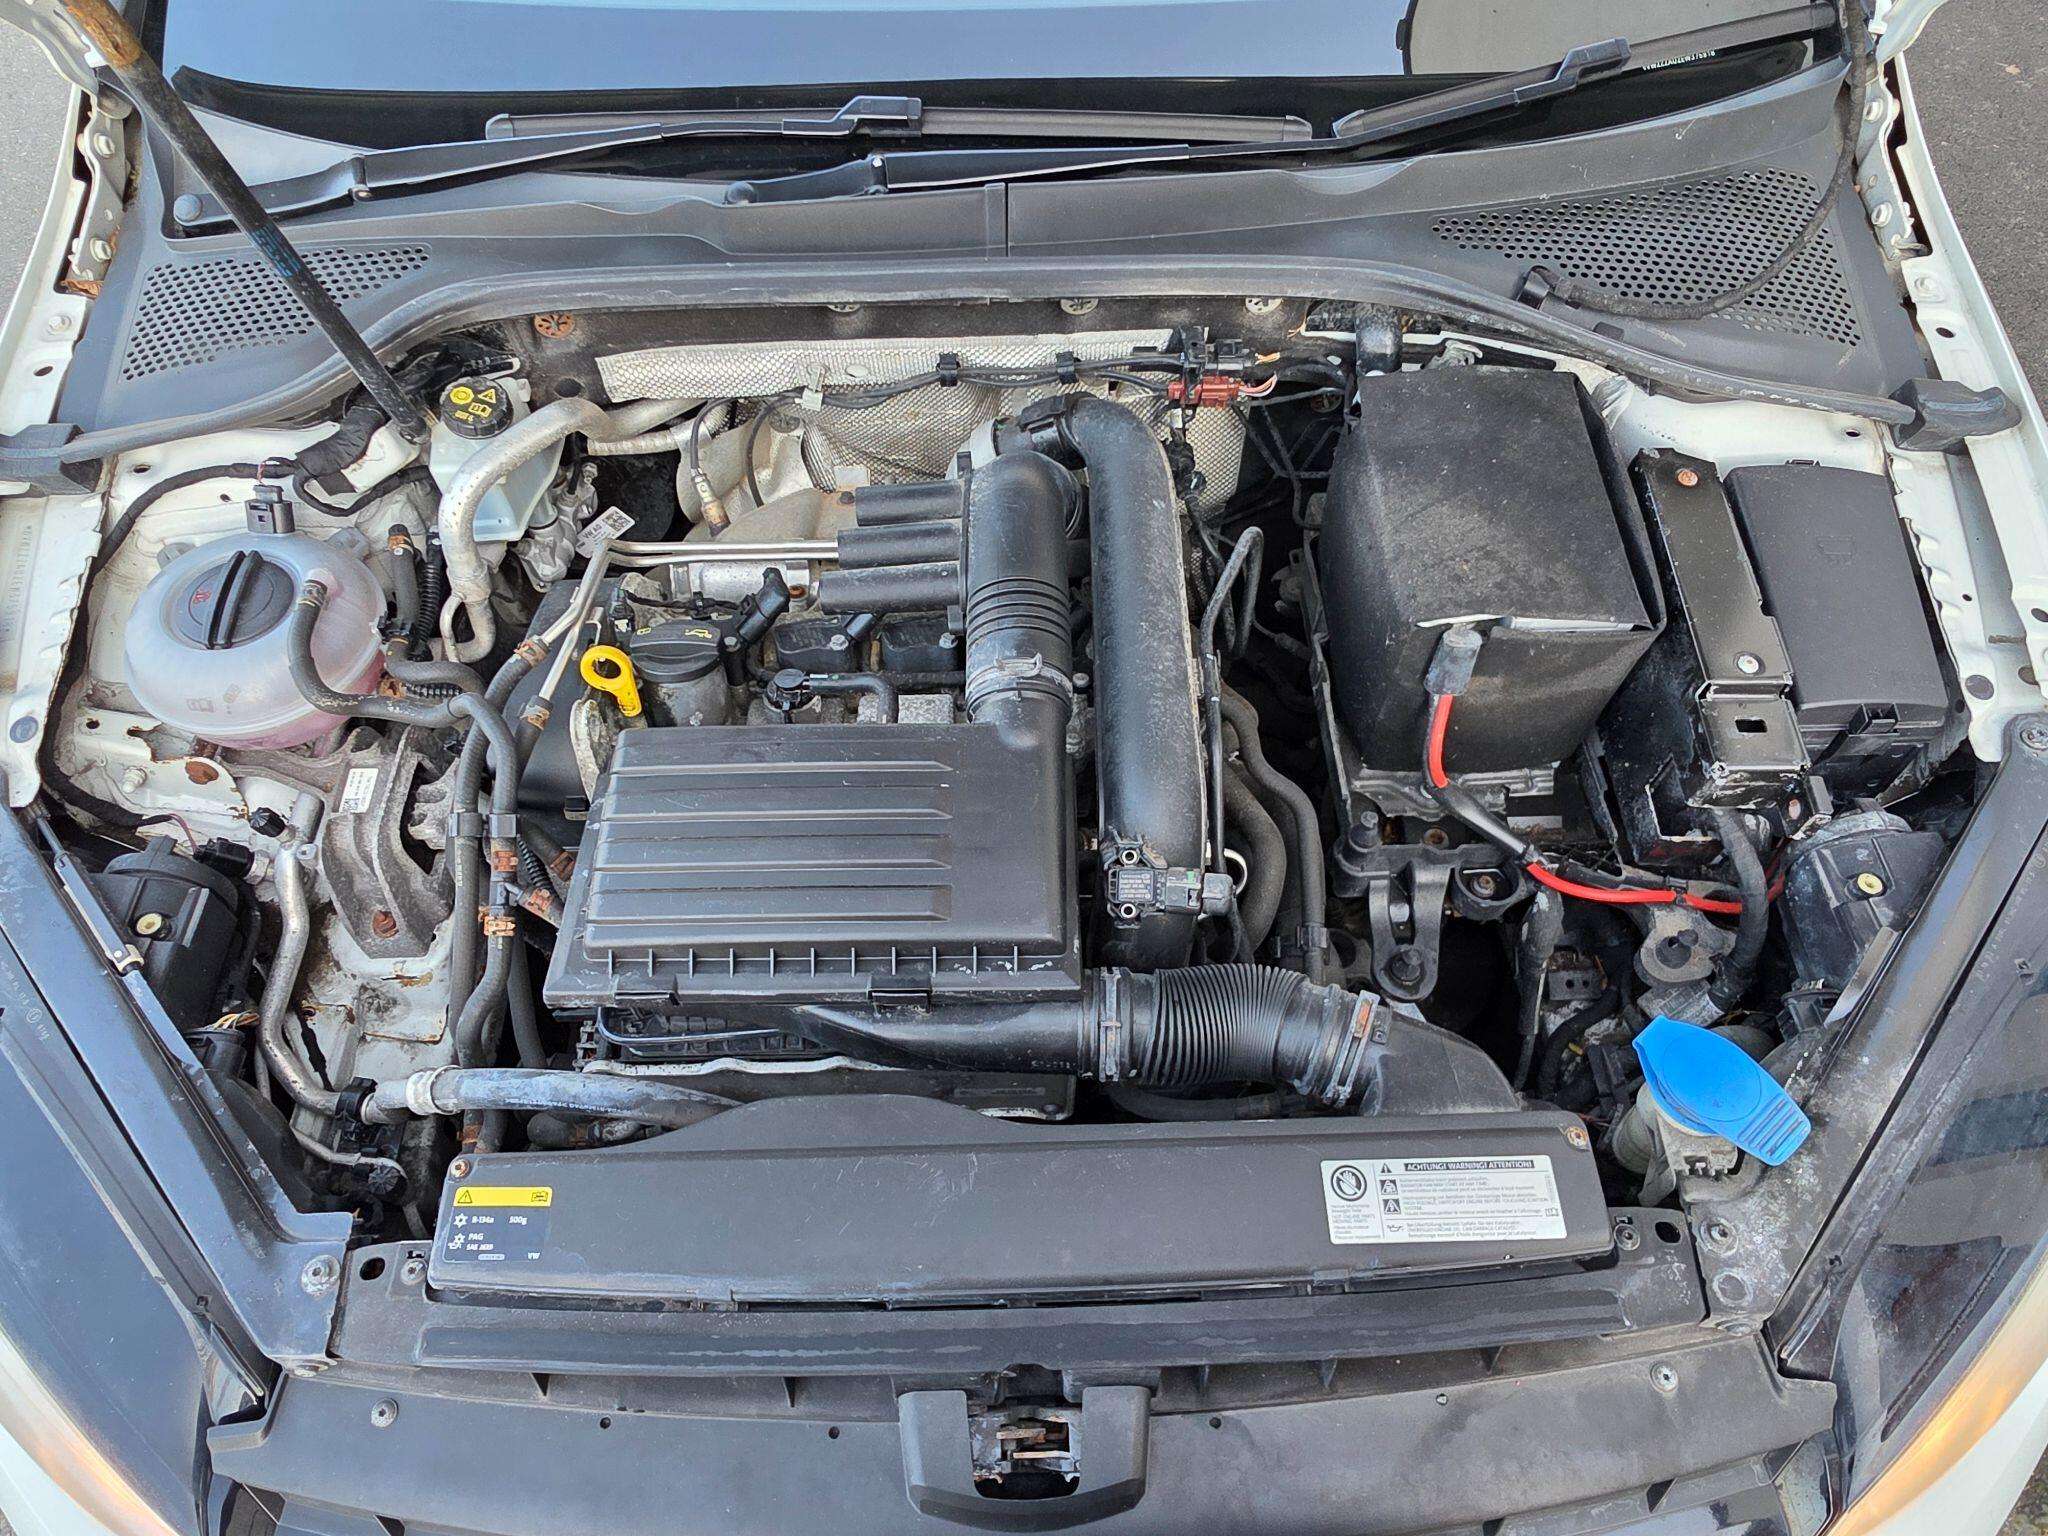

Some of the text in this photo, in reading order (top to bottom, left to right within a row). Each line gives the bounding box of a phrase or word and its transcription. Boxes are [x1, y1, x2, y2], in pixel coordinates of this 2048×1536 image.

[1407, 1160, 1532, 1171] ACHTUNG! WARNING! ATTENTION!
[527, 1252, 540, 1260] VW
